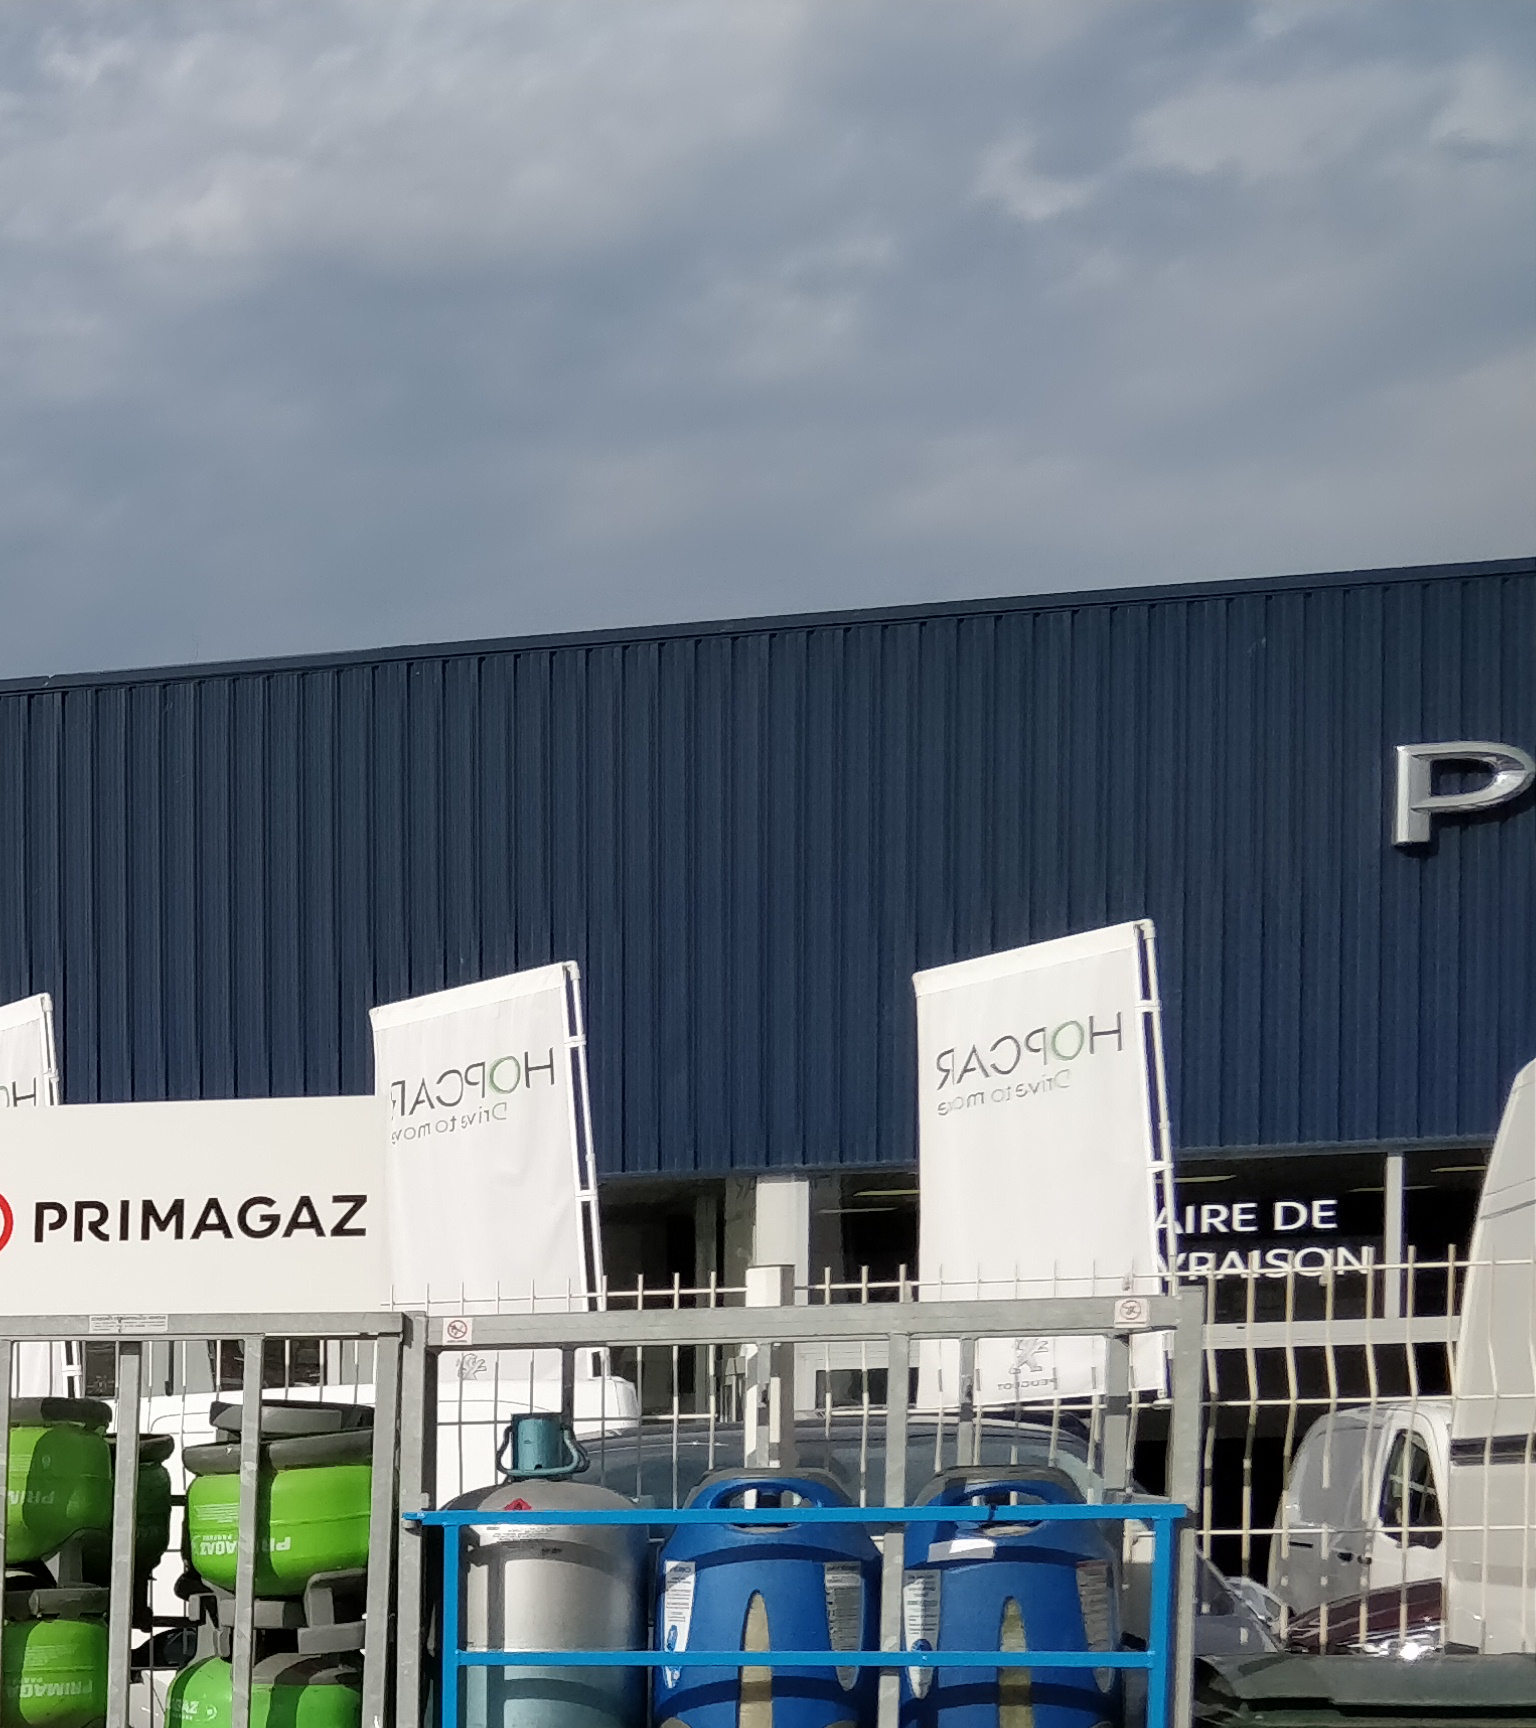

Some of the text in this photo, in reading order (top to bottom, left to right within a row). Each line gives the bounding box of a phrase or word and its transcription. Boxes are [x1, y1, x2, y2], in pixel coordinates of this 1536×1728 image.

[33, 1193, 368, 1244] PRIMAGAZ
[1155, 1199, 1338, 1235] AIRE DE
